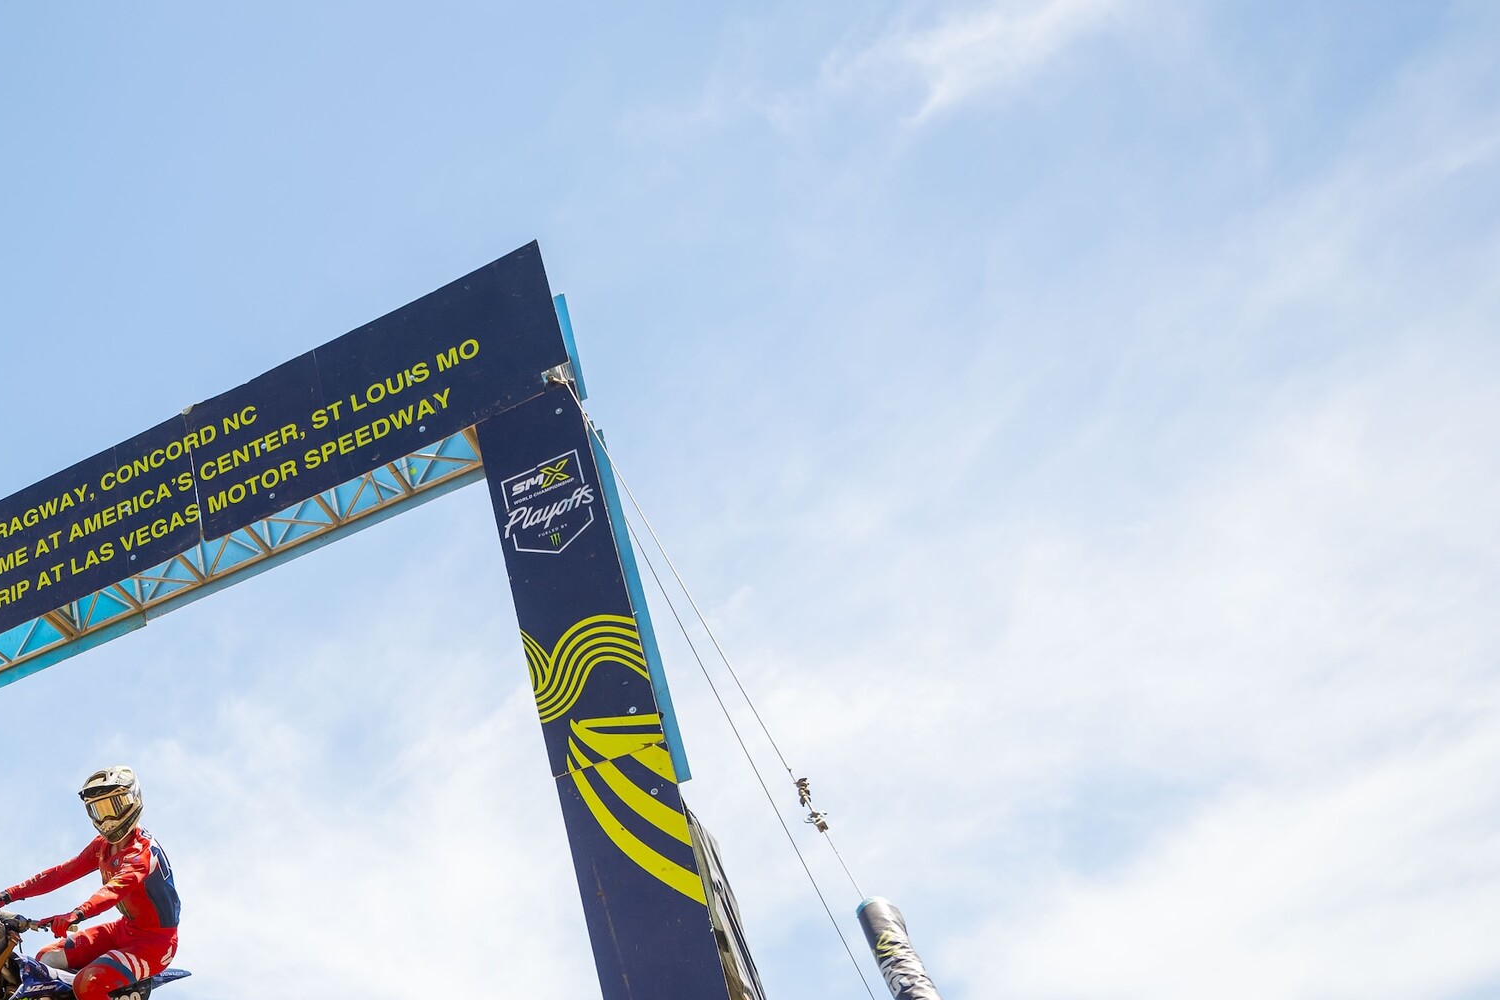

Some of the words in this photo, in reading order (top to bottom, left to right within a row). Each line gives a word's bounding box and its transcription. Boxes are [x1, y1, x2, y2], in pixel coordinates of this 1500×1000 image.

[35, 530, 62, 558] AT
[69, 471, 194, 542] AMERICA'S
[200, 423, 306, 481] CENTER,
[311, 400, 343, 430] ST
[350, 362, 430, 412] LOUIS
[436, 338, 480, 372] MO
[100, 425, 216, 491] CONCORD
[222, 405, 258, 434] NC
[36, 563, 64, 591] AT
[70, 542, 115, 576] LAS
[120, 503, 200, 551] VEGAS
[207, 459, 298, 514] MOTOR
[304, 387, 451, 470] SPEEDWAY
[512, 458, 570, 497] SMX
[514, 494, 533, 505] WORLD
[533, 477, 575, 498] CHAMPIONSHIP
[505, 484, 594, 539] Playoffs
[538, 526, 559, 538] FUELED
[560, 522, 568, 530] BY
